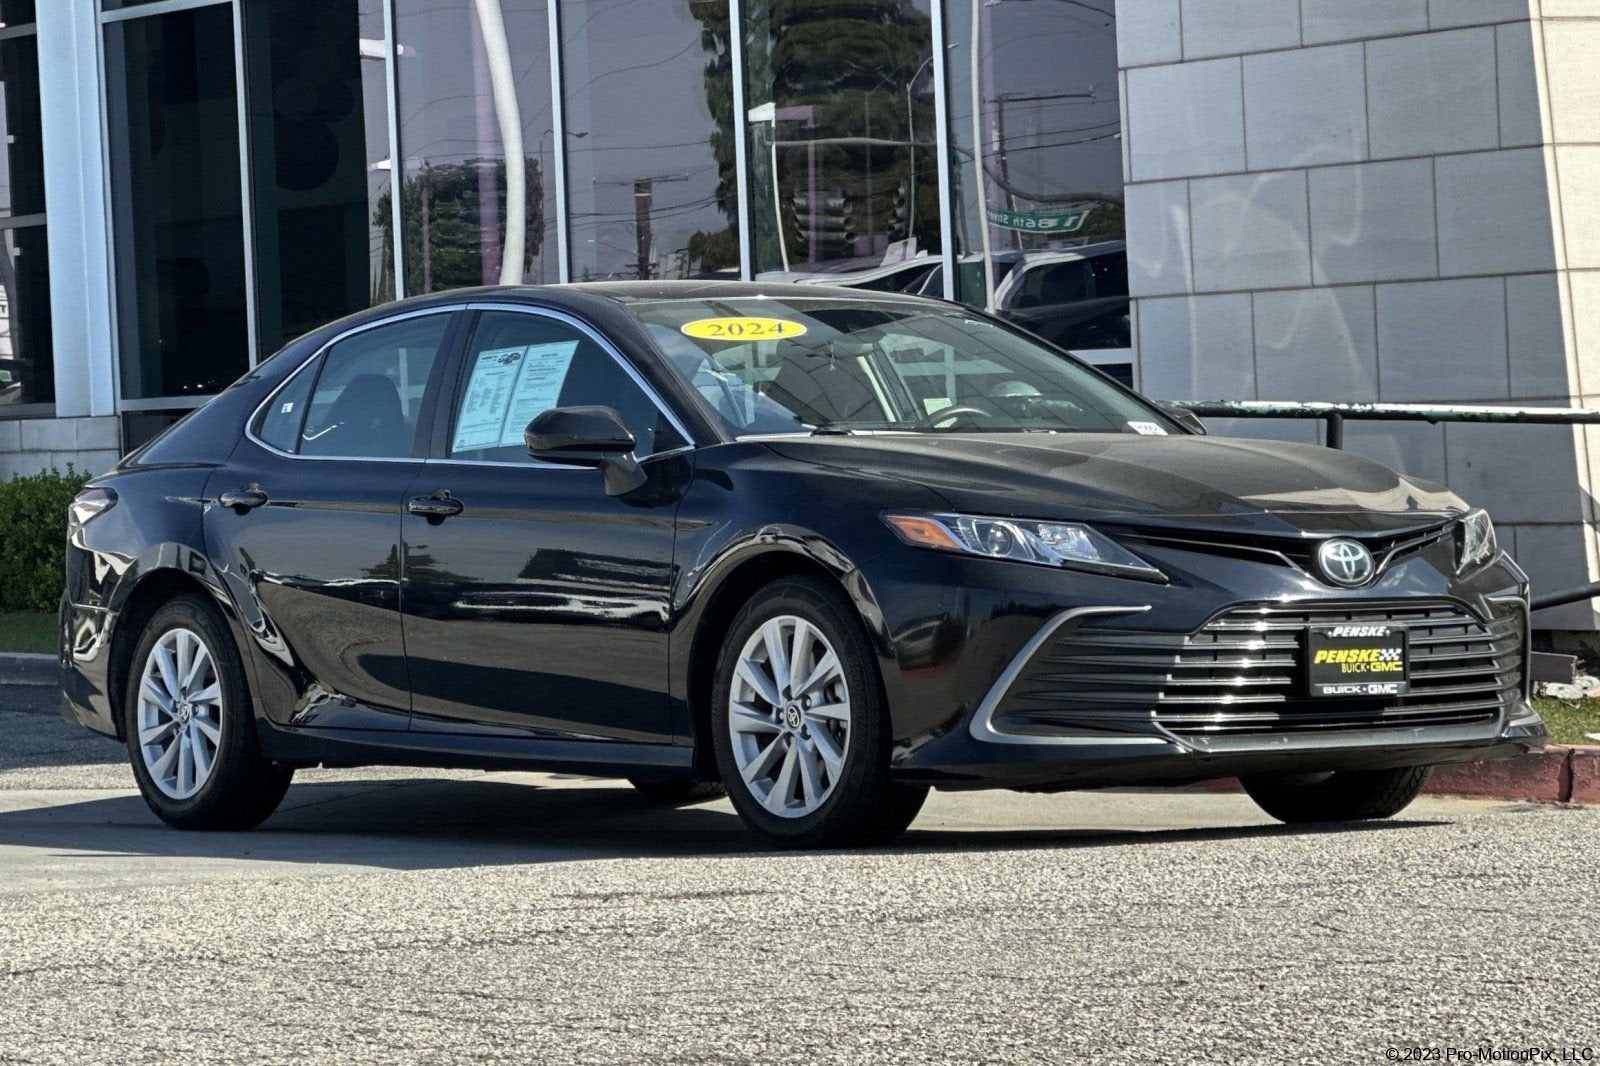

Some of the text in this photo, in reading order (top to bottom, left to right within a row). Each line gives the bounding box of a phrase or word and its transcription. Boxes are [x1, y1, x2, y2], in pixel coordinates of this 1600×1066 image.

[708, 322, 786, 336] 2024
[1332, 626, 1387, 637] PENSKE
[1314, 648, 1381, 664] PENSKE
[1323, 684, 1398, 694] BUICK GMC
